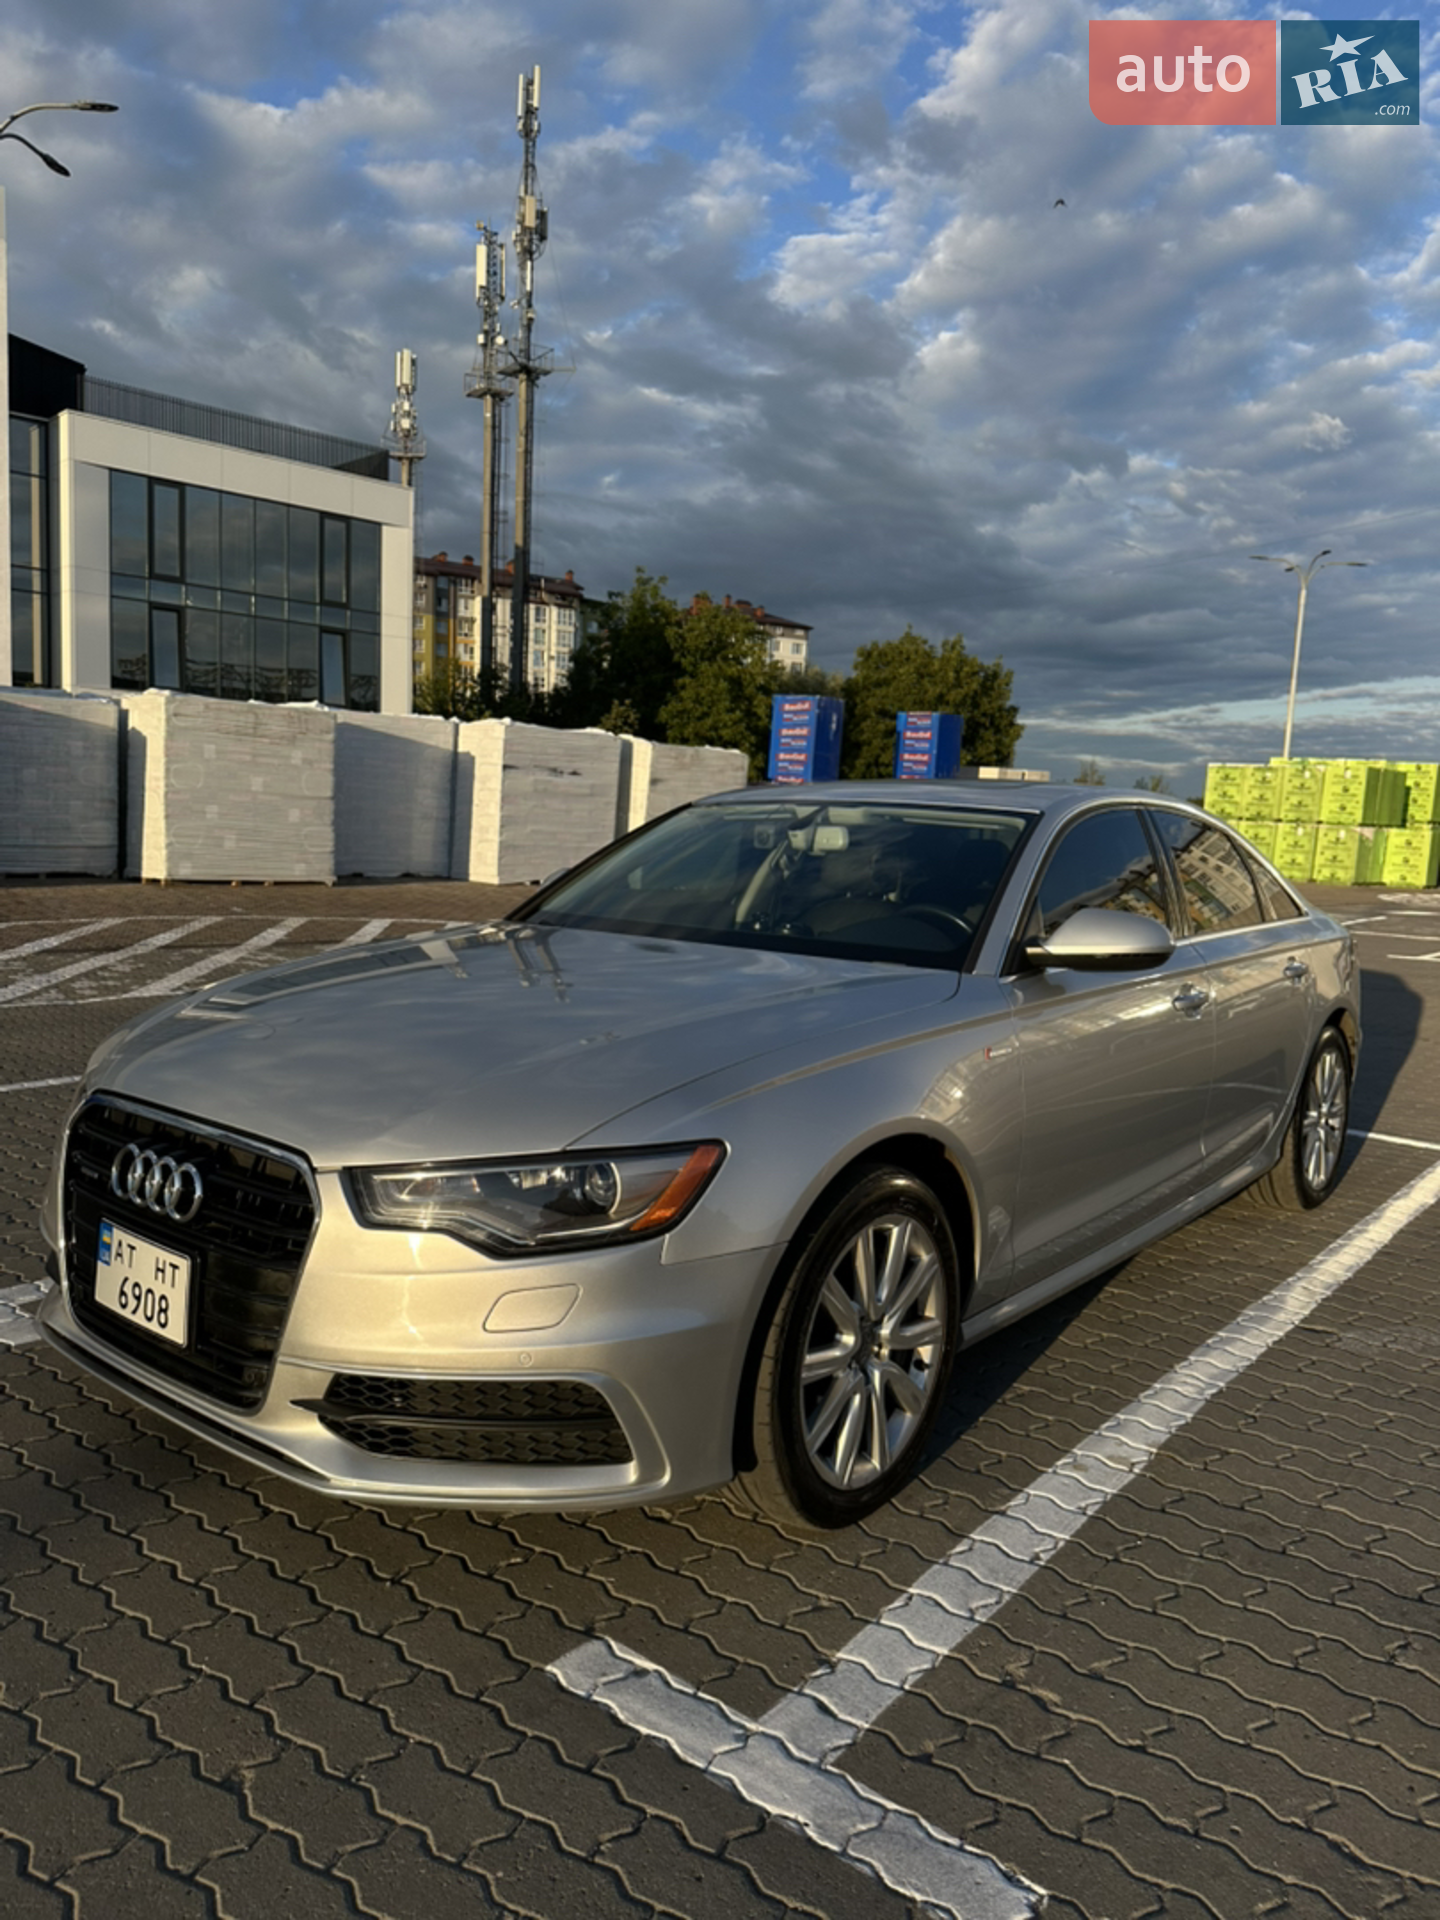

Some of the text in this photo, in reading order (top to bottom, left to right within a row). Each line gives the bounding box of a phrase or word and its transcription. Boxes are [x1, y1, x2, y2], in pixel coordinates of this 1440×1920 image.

[114, 1239, 180, 1289] AT HT
[118, 1276, 169, 1329] 6908
